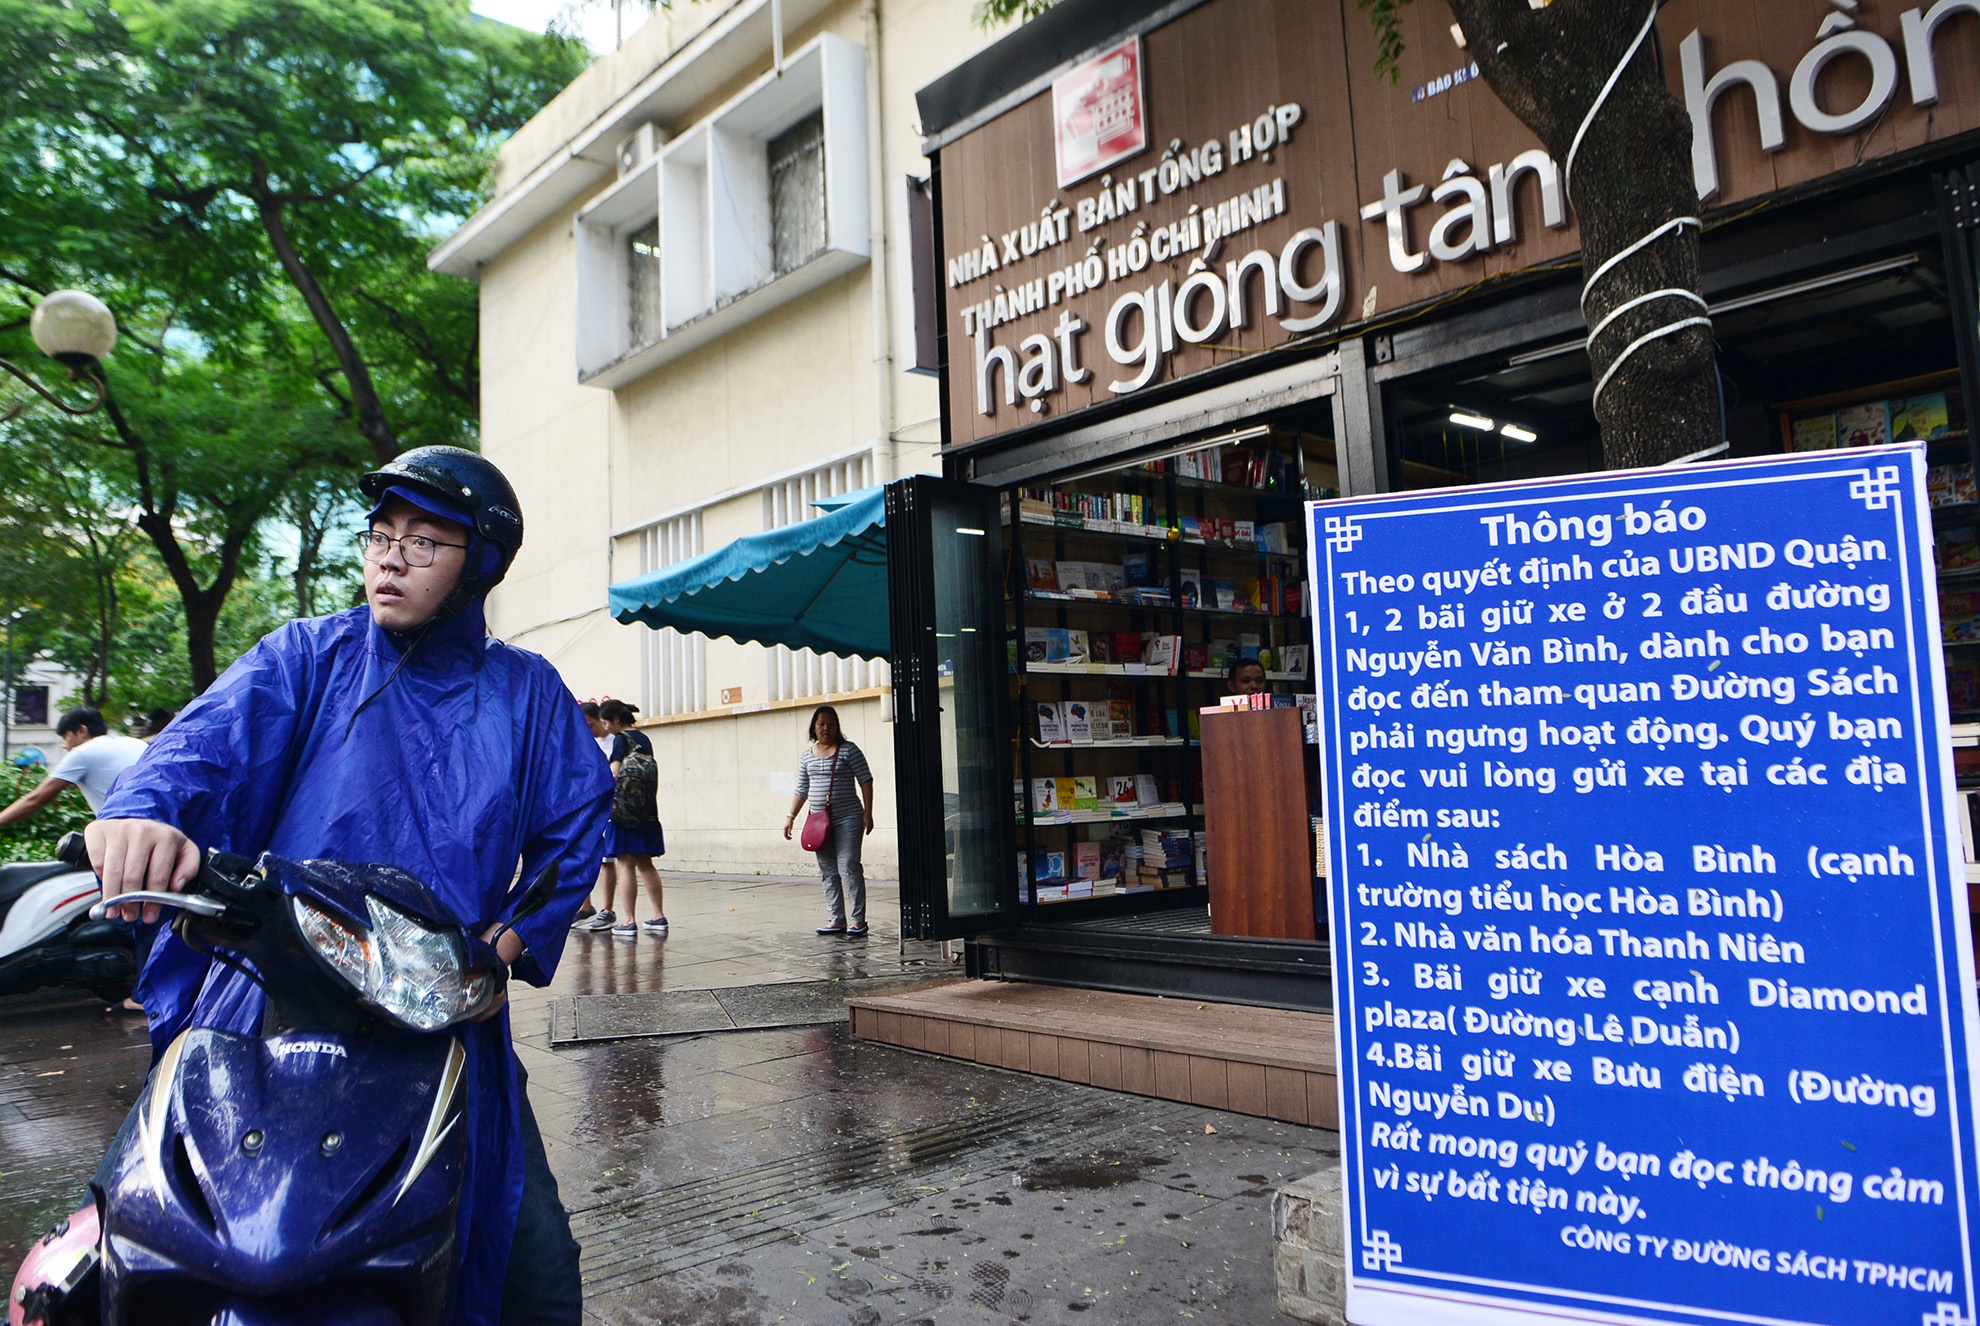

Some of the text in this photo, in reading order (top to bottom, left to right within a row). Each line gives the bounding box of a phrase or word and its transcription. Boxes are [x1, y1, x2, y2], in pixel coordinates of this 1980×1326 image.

[948, 102, 1303, 288] NHÀ XUẤT BẢN TỔNG HỢP
[961, 177, 1288, 337] THÀNH PHỐ HỒ CHÍ MINH
[974, 310, 1093, 416] hạt
[1105, 220, 1343, 395] giống
[1479, 499, 1707, 547] Thông báo
[1340, 534, 1887, 596] Theo quyết định của UBND Quận
[1345, 580, 1891, 637] 1, 2 bãi giữ xe ở 2 đầu đường
[1346, 623, 1895, 678] Nguyễn Văn Bình, dành cho bạn
[1347, 665, 1899, 717] đọc đến tham quan Đường Sách
[1350, 722, 1415, 756] phải
[1425, 724, 1528, 754] ngưng
[1539, 719, 1616, 752] hoạt
[1626, 716, 1729, 751] động.
[1739, 712, 1817, 749] Quý
[1828, 711, 1903, 748] bạn
[1351, 755, 1907, 795] đọc vui lòng gửi xe tại các địa
[1353, 798, 1500, 828] điểm sau:
[1357, 841, 1915, 883] 1. Nhà sách Hòa Bình (cạnh
[1357, 879, 1784, 923] trường tiểu học Hòa Bình)
[1360, 921, 1805, 964] 2. Nhà văn hóa Thanh Niên
[1362, 961, 1928, 1015] 3. Bãi giữ xe cạnh Diamond
[277, 1041, 348, 1058] HONDA
[1365, 1000, 1458, 1036] plaza(
[1463, 1006, 1576, 1047] Đường
[1584, 1013, 1624, 1043] Lê
[1369, 1081, 1490, 1120] Nguyễn
[1461, 1048, 1516, 1082] giữ
[1532, 1059, 1572, 1082] xe
[1592, 1057, 1662, 1089] Bưu
[1683, 1062, 1765, 1102] điện
[1788, 1069, 1936, 1117] (Đường
[1371, 1121, 1944, 1205] Rất mong quý bạn đọc thông cảm
[1373, 1163, 1647, 1225] vì sự bất tiện này.
[1561, 1224, 1953, 1294] CÔNG TY ĐƯỜNG SÁCH TPHCM
